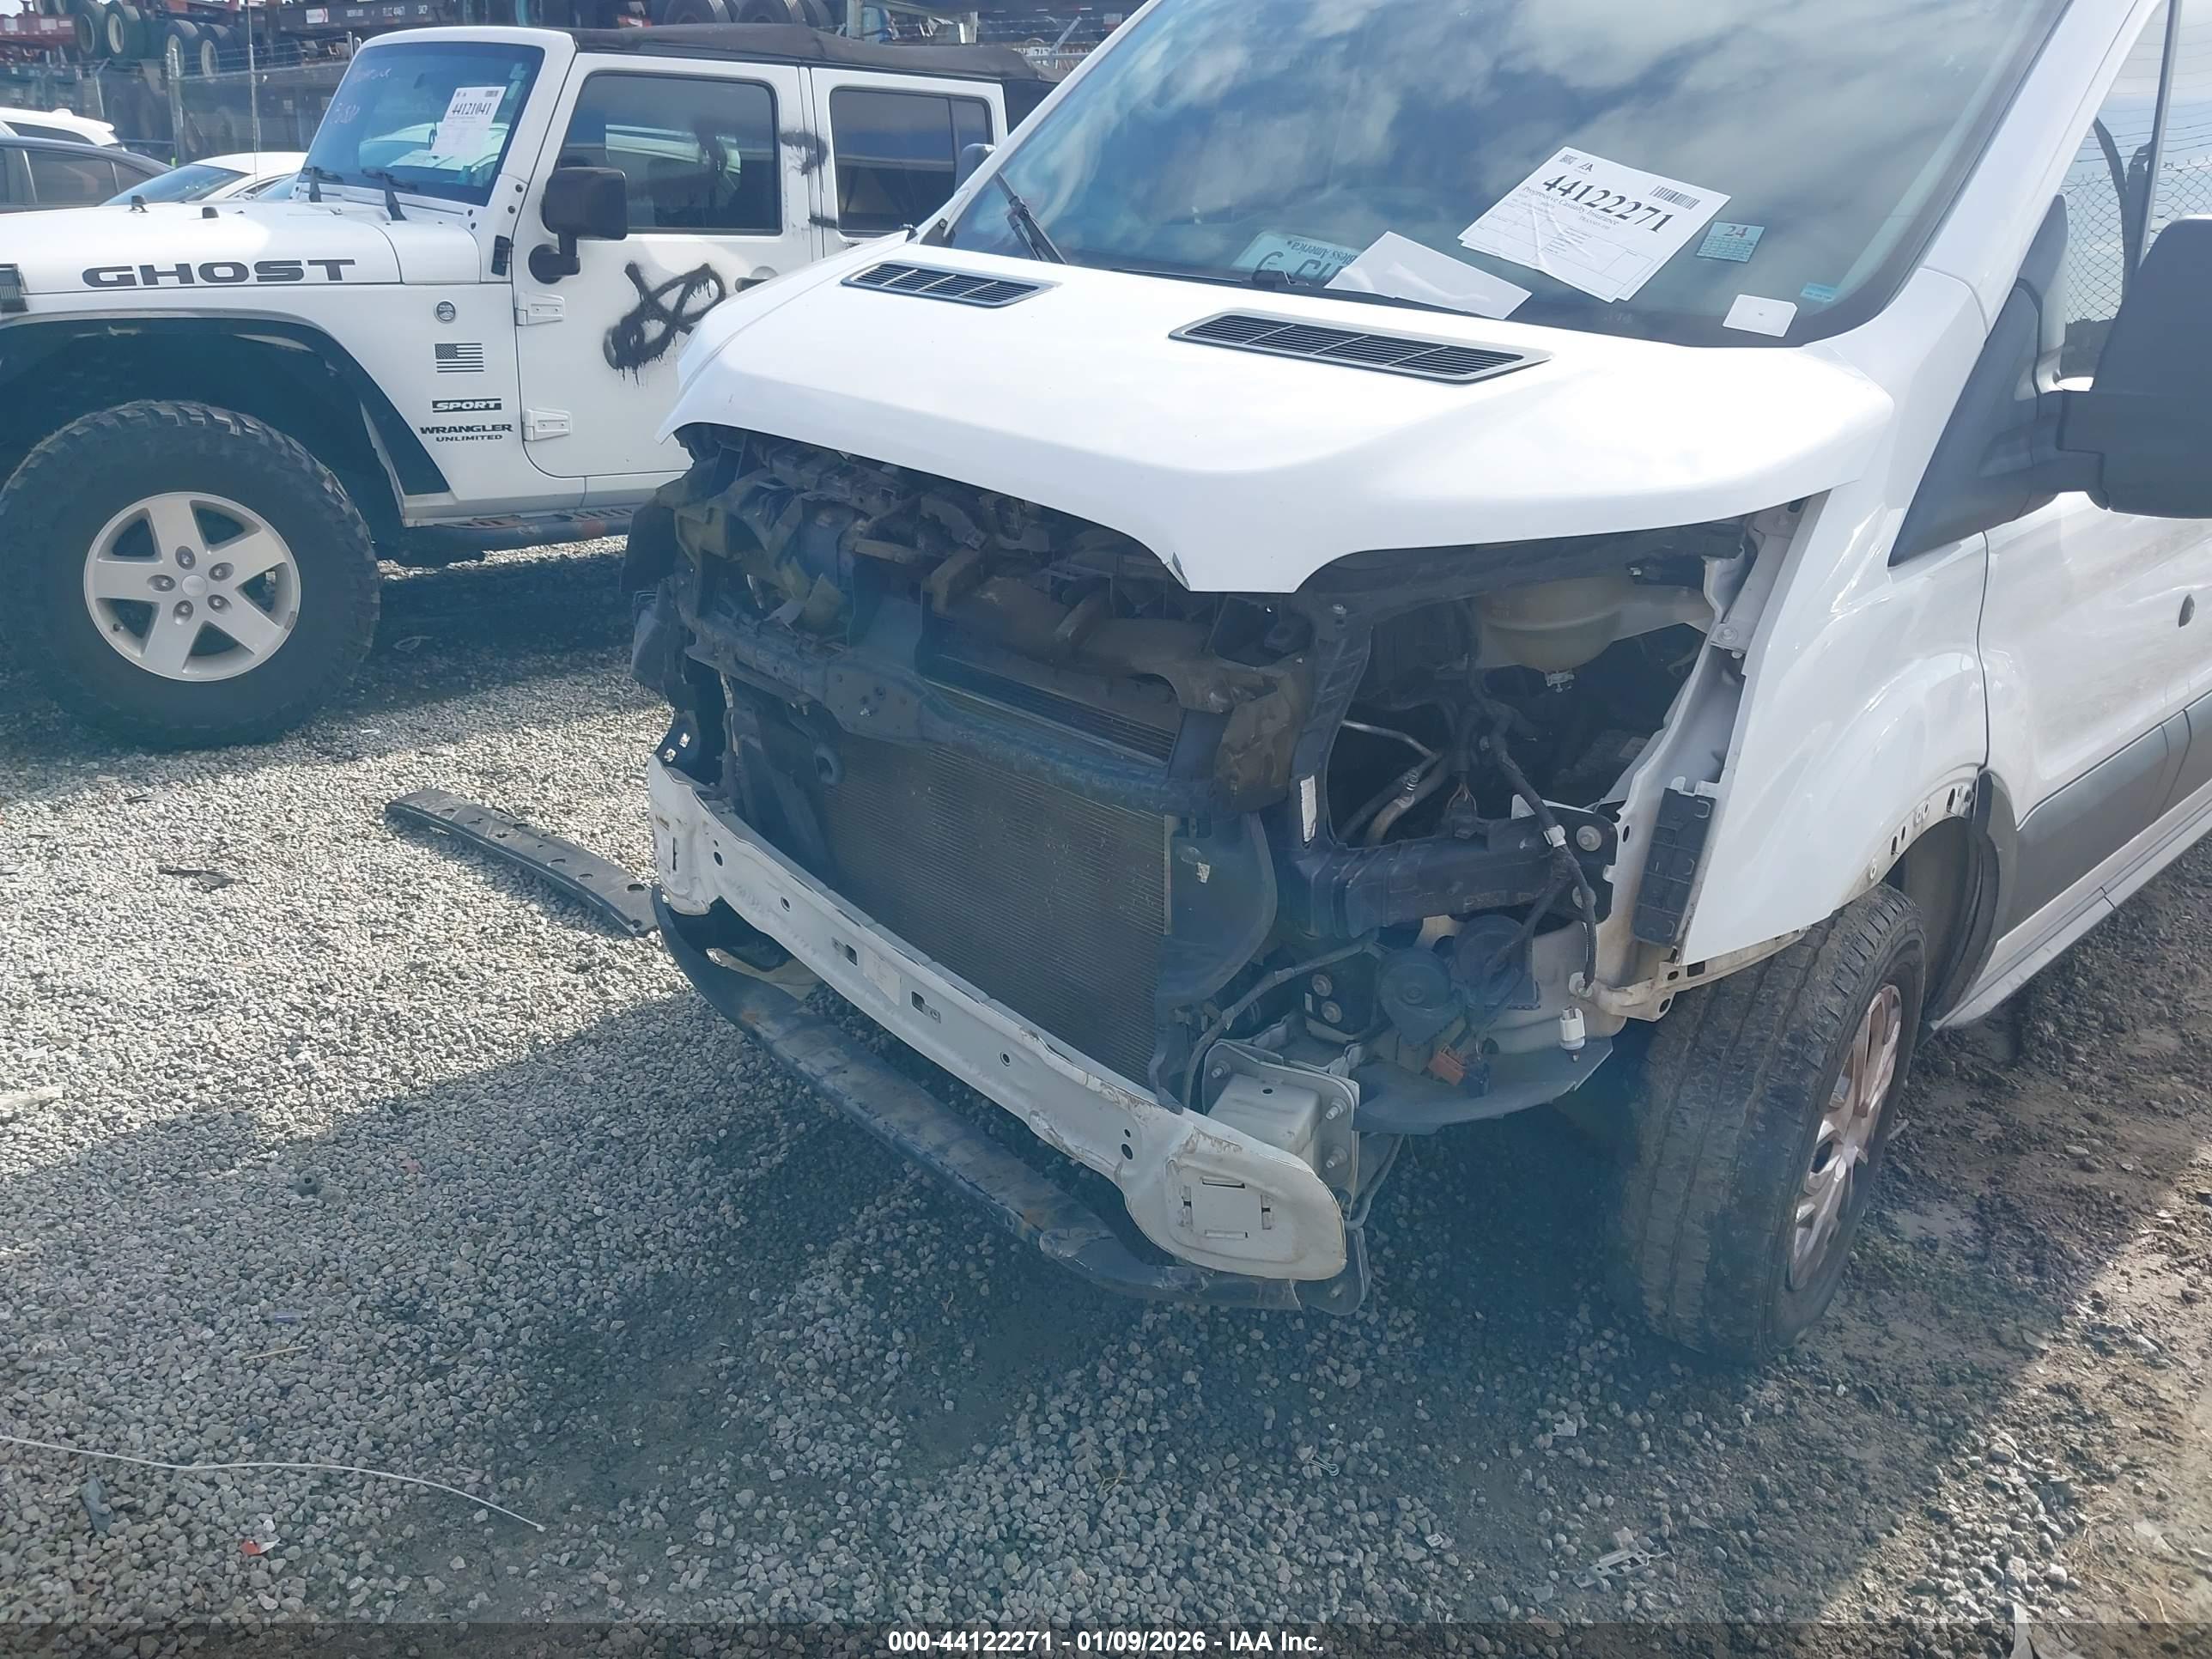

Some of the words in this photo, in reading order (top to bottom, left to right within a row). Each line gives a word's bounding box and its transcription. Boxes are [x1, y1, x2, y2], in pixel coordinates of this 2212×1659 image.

[452, 102, 492, 116] 44121041
[1542, 174, 1674, 234] 44122271
[1723, 225, 1749, 239] 24
[82, 258, 356, 288] GHOST
[435, 400, 499, 411] SPORT
[419, 423, 514, 434] WRANGLER
